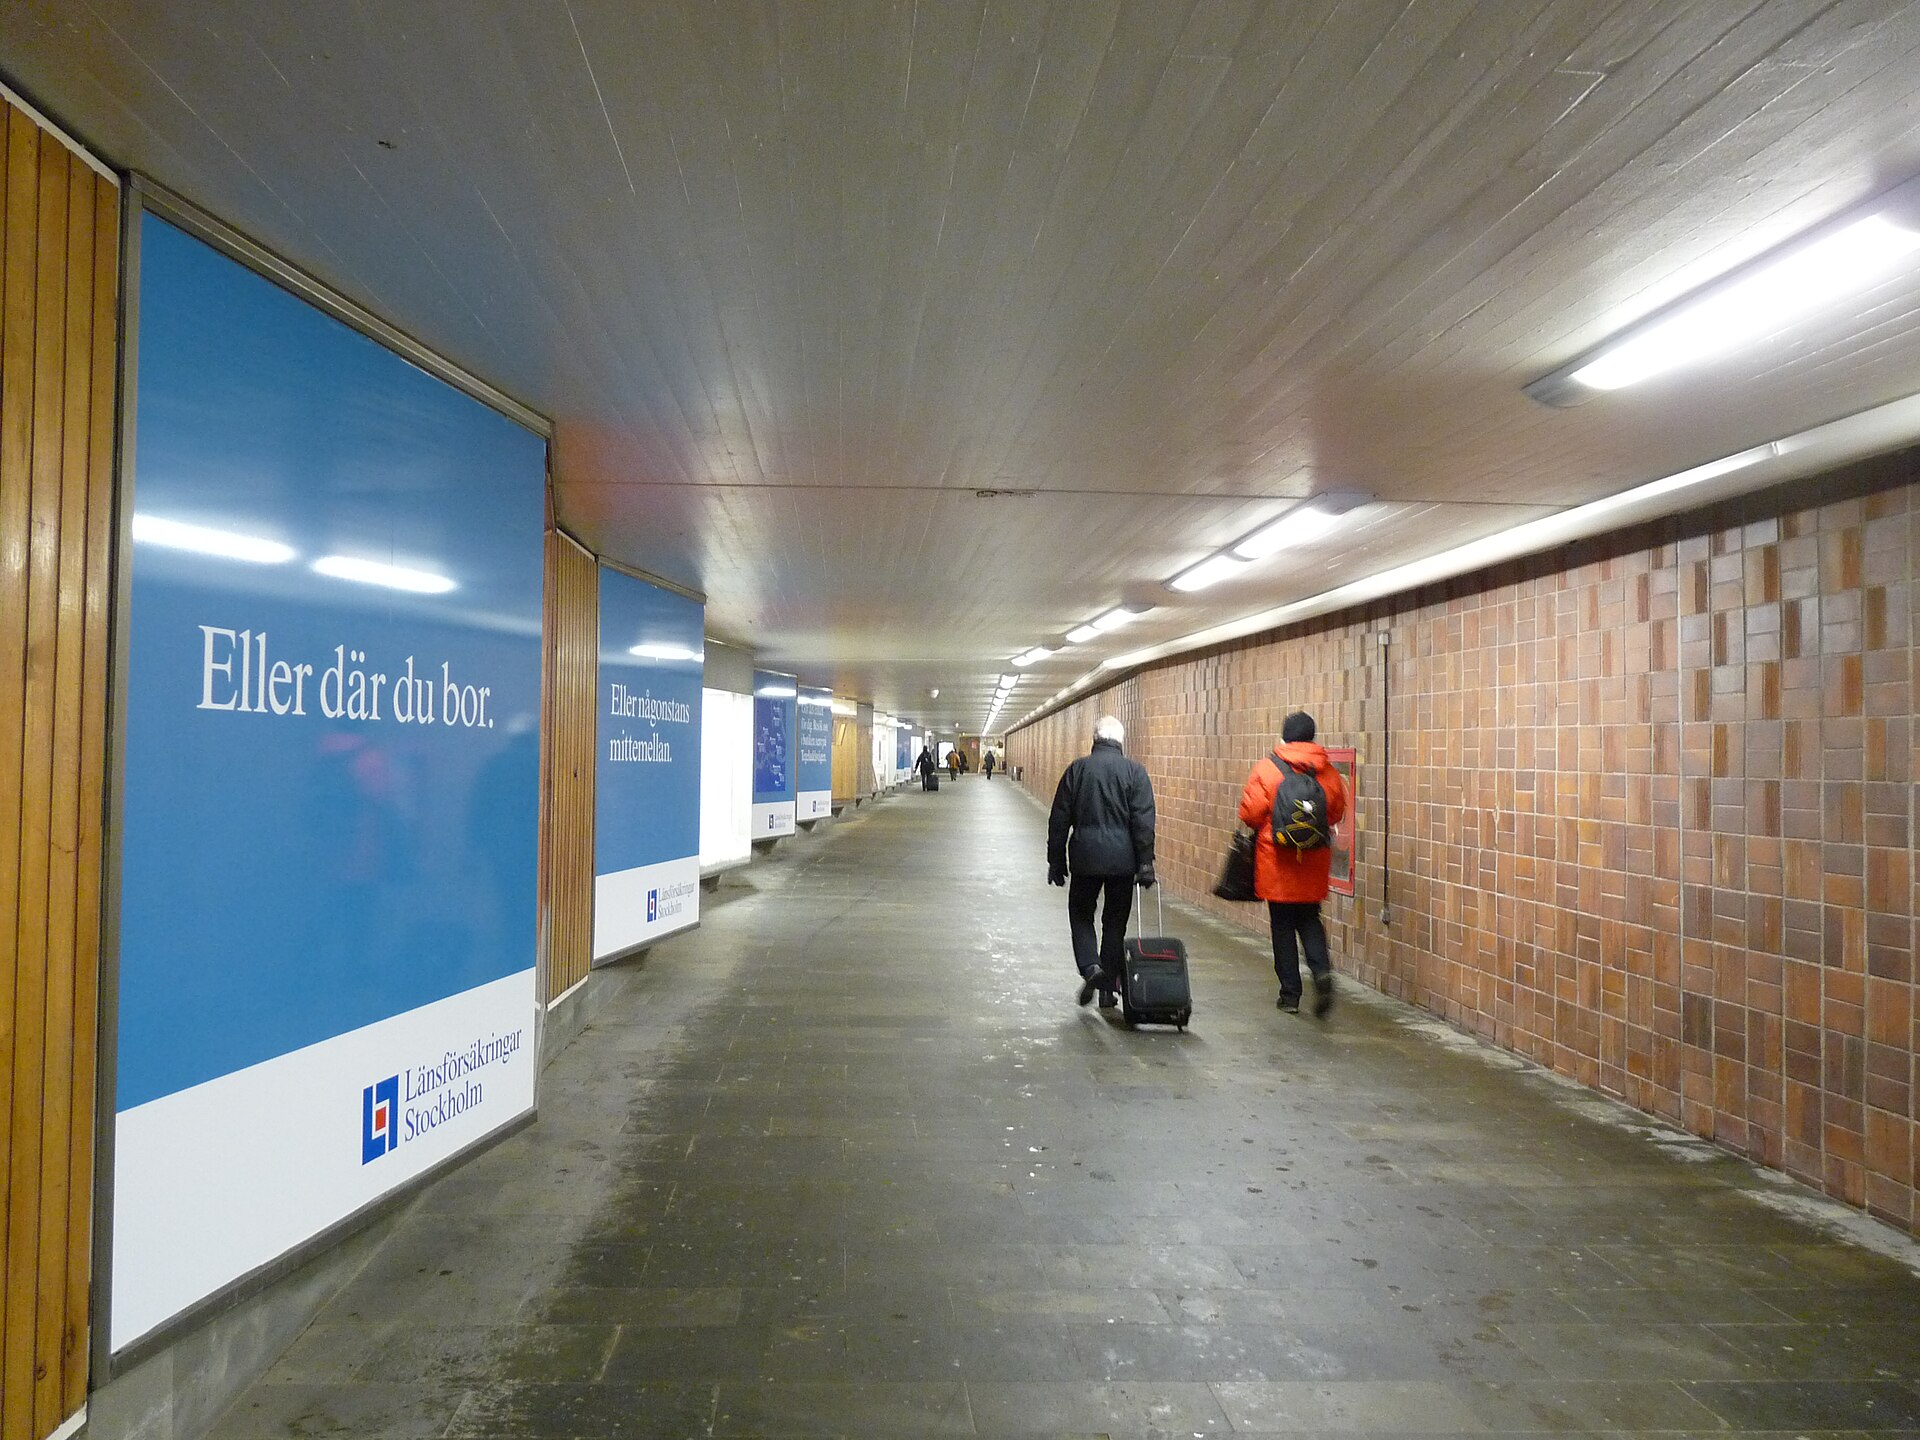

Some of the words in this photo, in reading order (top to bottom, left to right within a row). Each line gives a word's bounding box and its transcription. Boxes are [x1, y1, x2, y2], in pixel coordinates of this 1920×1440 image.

[196, 625, 313, 715] Eller
[320, 644, 386, 720] där
[393, 655, 435, 724] du
[441, 661, 494, 729] bor.
[610, 683, 637, 717] Eller
[638, 689, 690, 728] någonstans
[610, 729, 673, 762] mittemellan.
[404, 1029, 522, 1103] Länsförsäkringar
[404, 1080, 483, 1142] Stockholm
